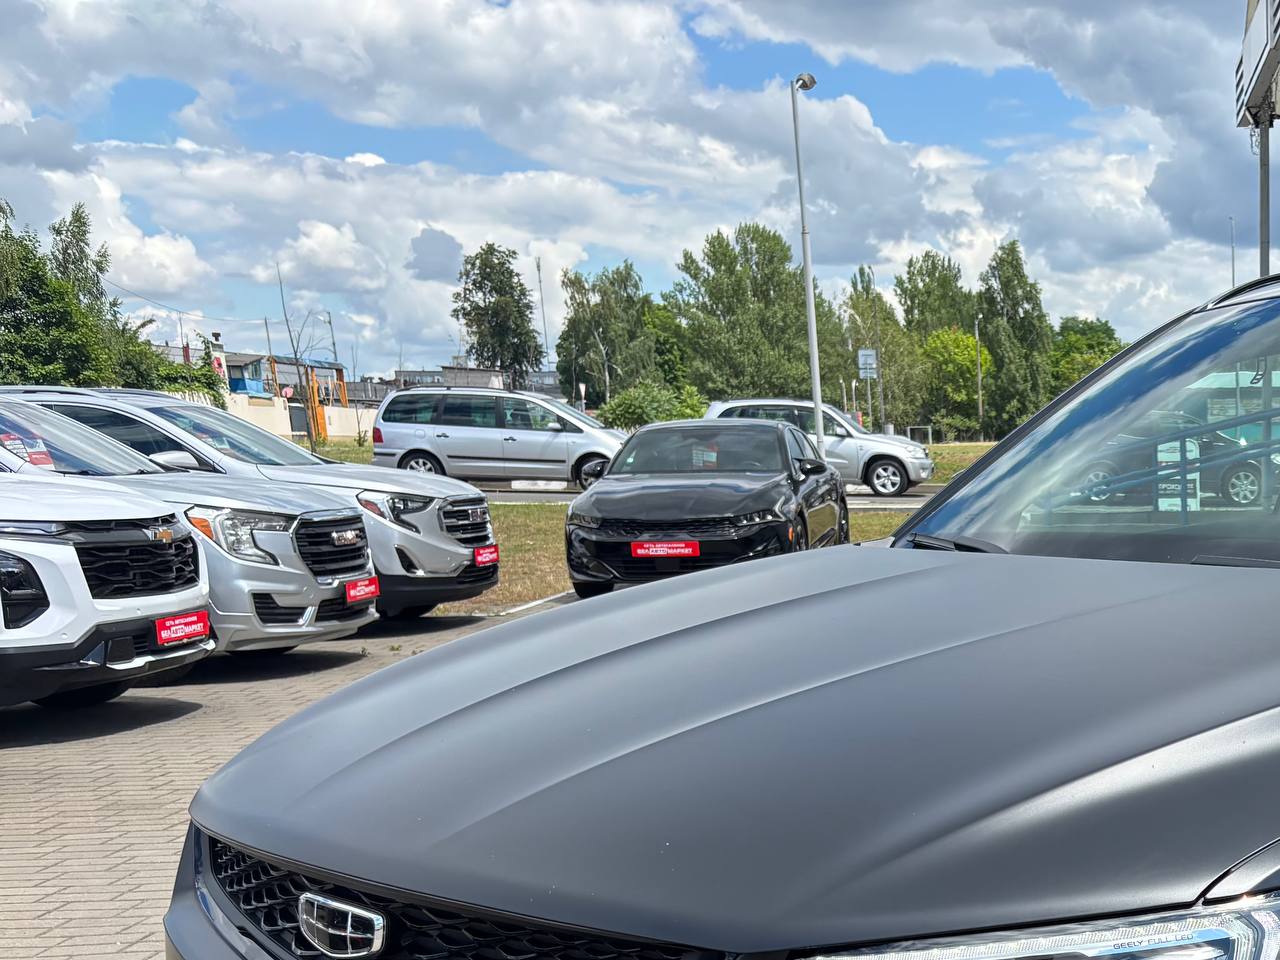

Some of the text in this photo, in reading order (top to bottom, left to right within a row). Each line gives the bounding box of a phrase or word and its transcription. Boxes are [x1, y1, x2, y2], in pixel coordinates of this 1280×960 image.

[1113, 933, 1194, 950] GEELY FULL LED
